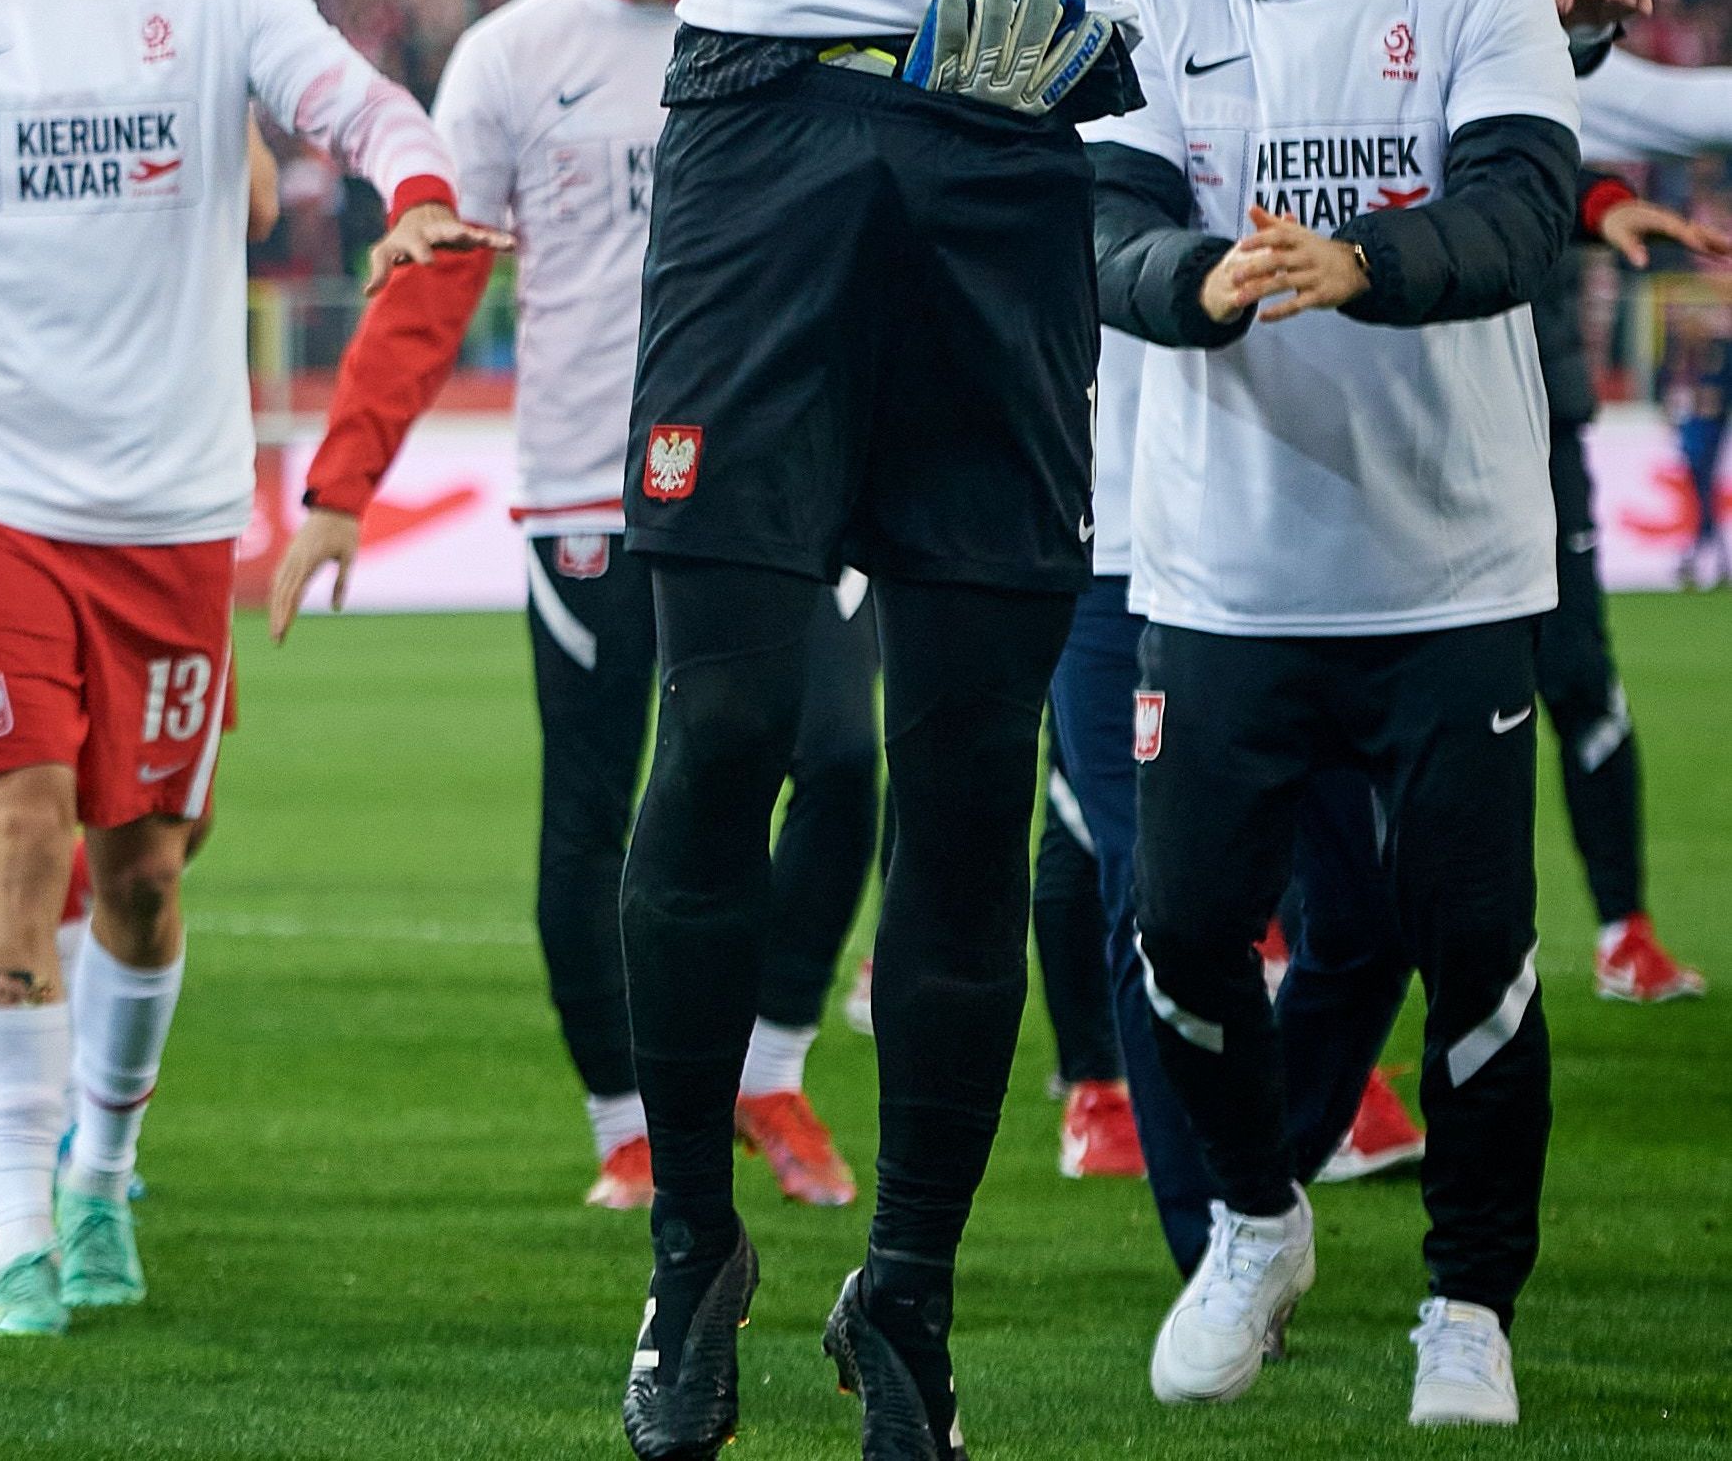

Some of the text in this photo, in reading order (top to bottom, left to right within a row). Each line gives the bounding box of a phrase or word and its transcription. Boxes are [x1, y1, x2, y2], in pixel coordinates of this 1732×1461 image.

[17, 113, 178, 156] KIERUNEK
[18, 160, 121, 202] KATAR
[142, 653, 211, 743] 13
